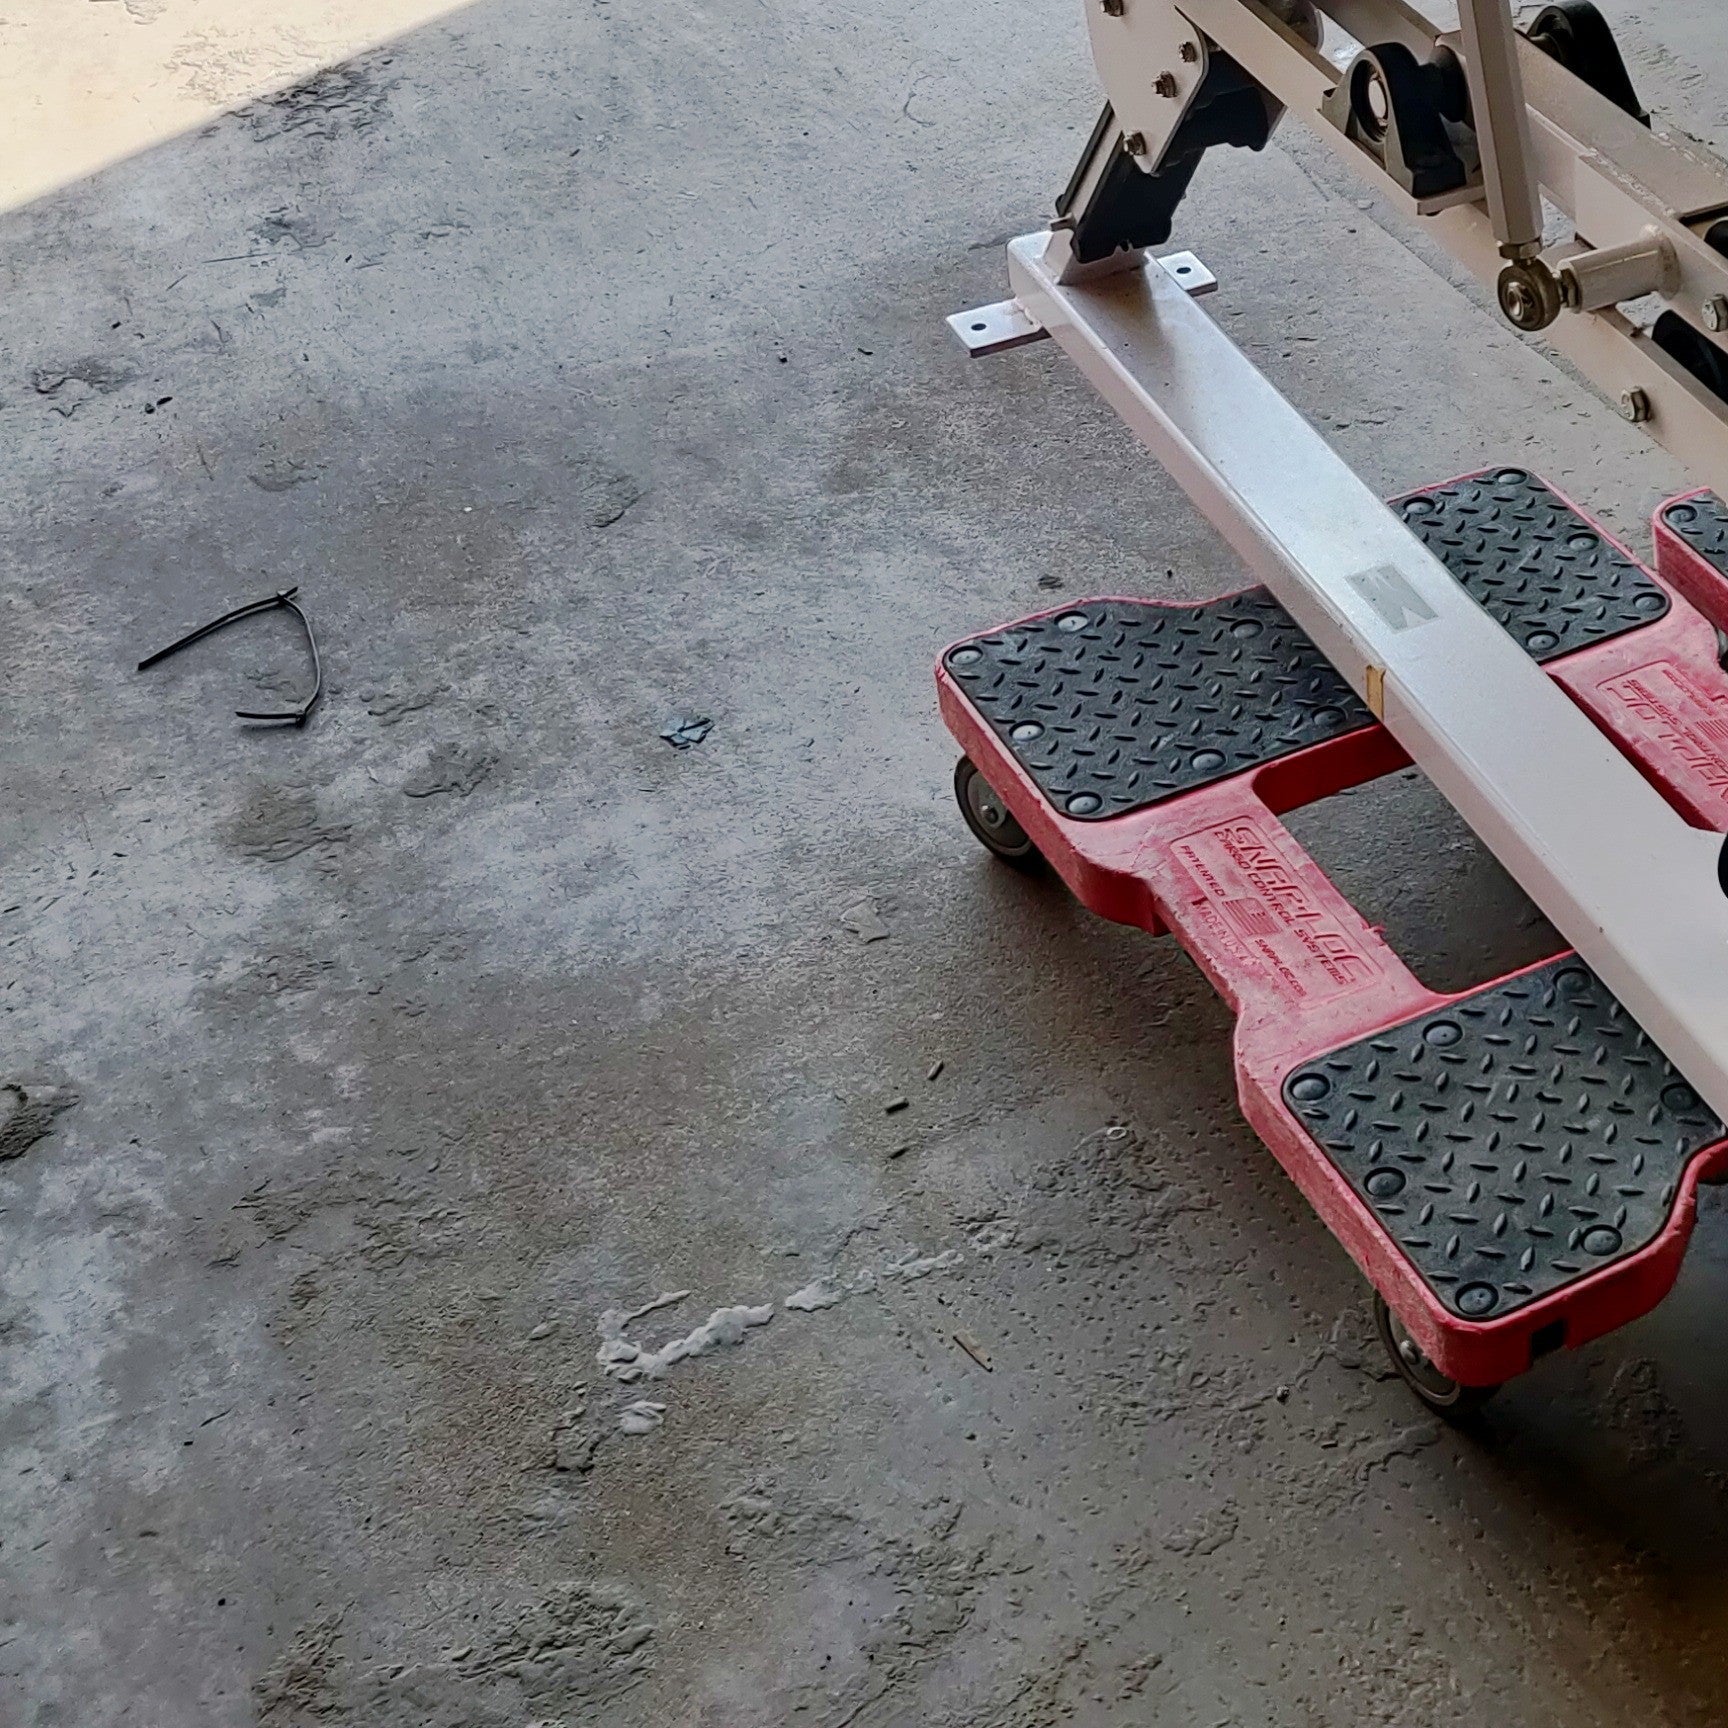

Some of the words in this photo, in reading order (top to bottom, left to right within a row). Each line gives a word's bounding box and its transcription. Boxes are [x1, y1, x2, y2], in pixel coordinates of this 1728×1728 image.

[1180, 844, 1226, 897] PATENTED
[1247, 872, 1296, 927] CONTROL
[1293, 928, 1349, 986] SYSTEMS
